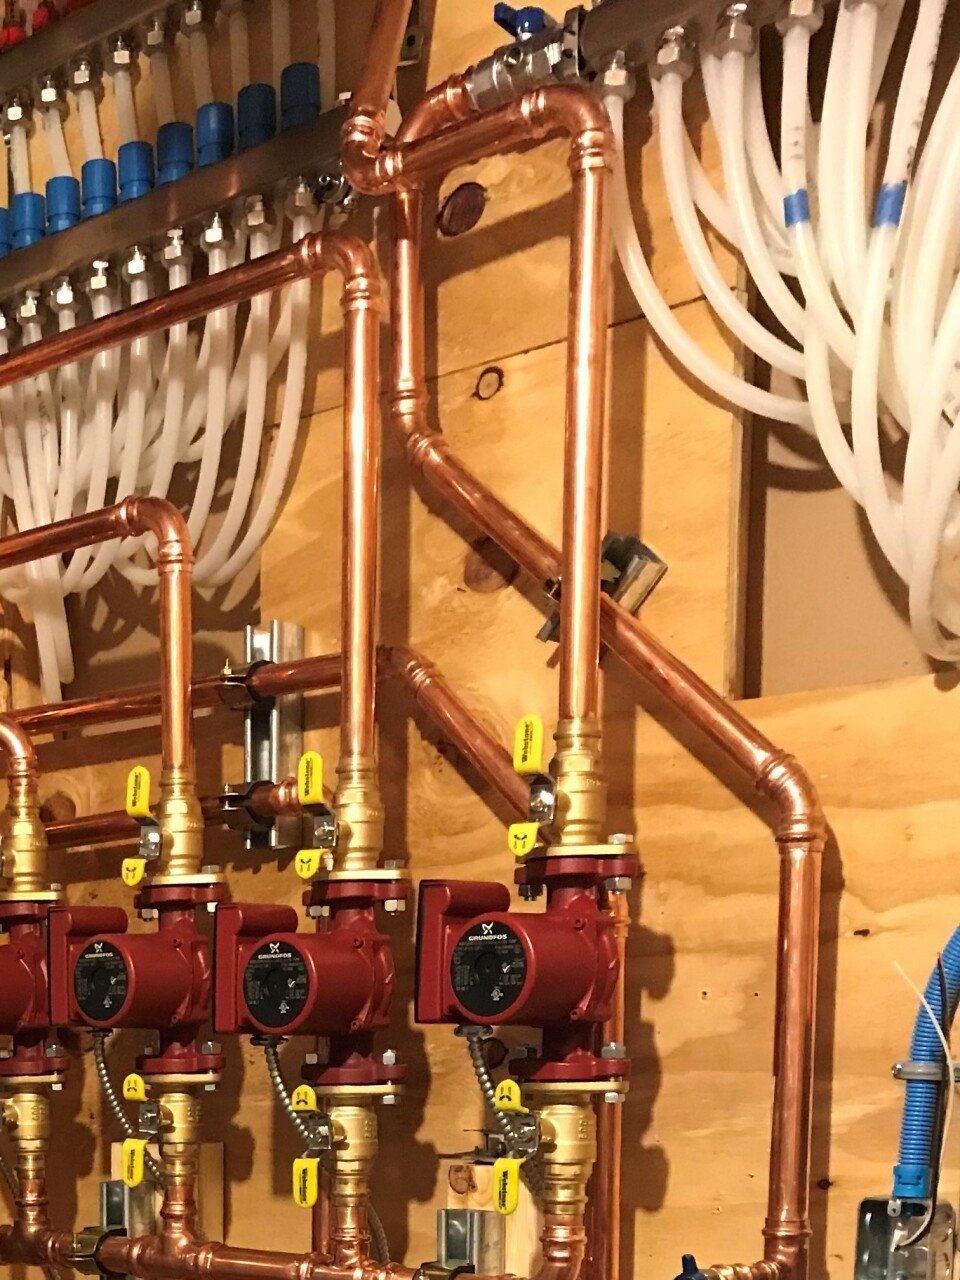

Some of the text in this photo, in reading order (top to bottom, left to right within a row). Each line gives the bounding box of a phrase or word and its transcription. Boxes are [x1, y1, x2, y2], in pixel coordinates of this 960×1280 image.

[521, 722, 530, 763] Webstone
[468, 933, 508, 941] GRUNDFOS
[258, 952, 292, 960] GRUNDFOS
